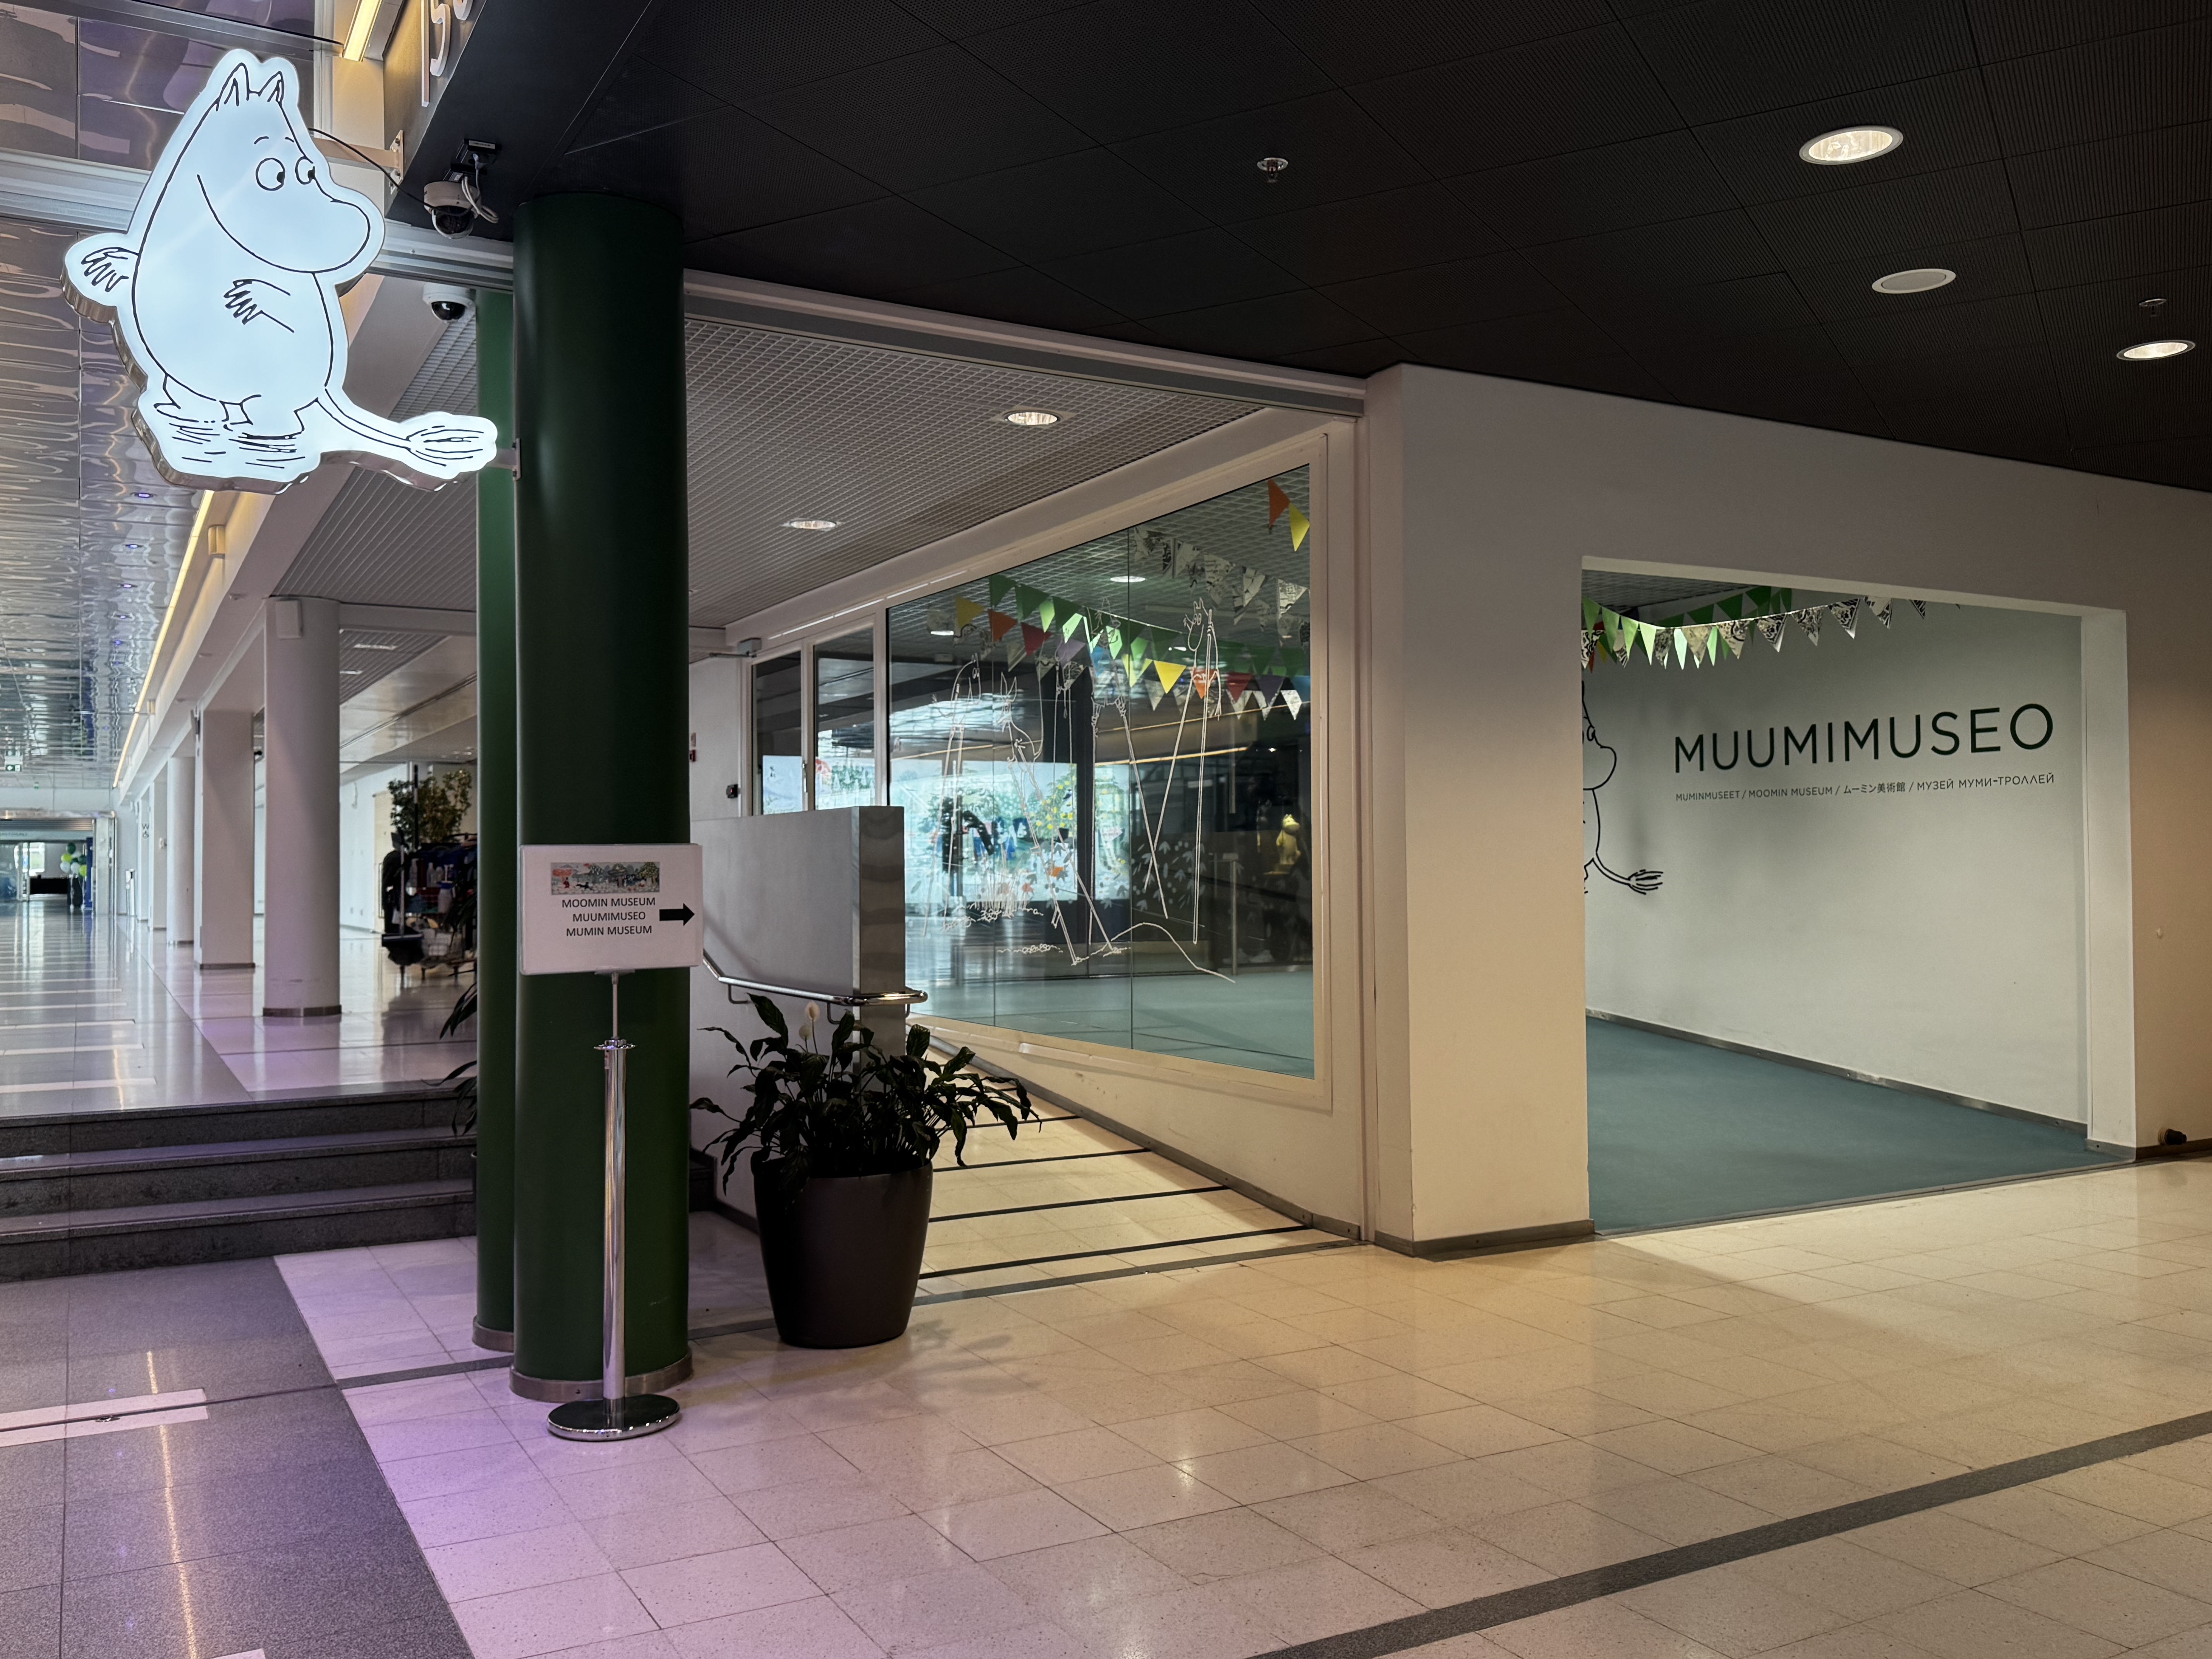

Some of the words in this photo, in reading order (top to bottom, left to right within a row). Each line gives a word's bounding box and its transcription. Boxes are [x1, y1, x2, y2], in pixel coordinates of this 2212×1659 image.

[1675, 703, 2053, 773] MUUMIMUSEO
[1676, 790, 1740, 801] MUMINMUSEET
[1748, 789, 1788, 798] MOOMIN
[1791, 787, 1832, 796] MUSEUM
[1843, 781, 1905, 794] ムーミン美術館
[1917, 778, 1954, 791] МУЗЕЙ
[562, 898, 608, 908] MOOMIN
[611, 897, 655, 907] MUSEUM
[573, 911, 646, 922] MUUMIMUSEO
[566, 927, 604, 936] MUMIN
[607, 925, 652, 935] MUSEUM
